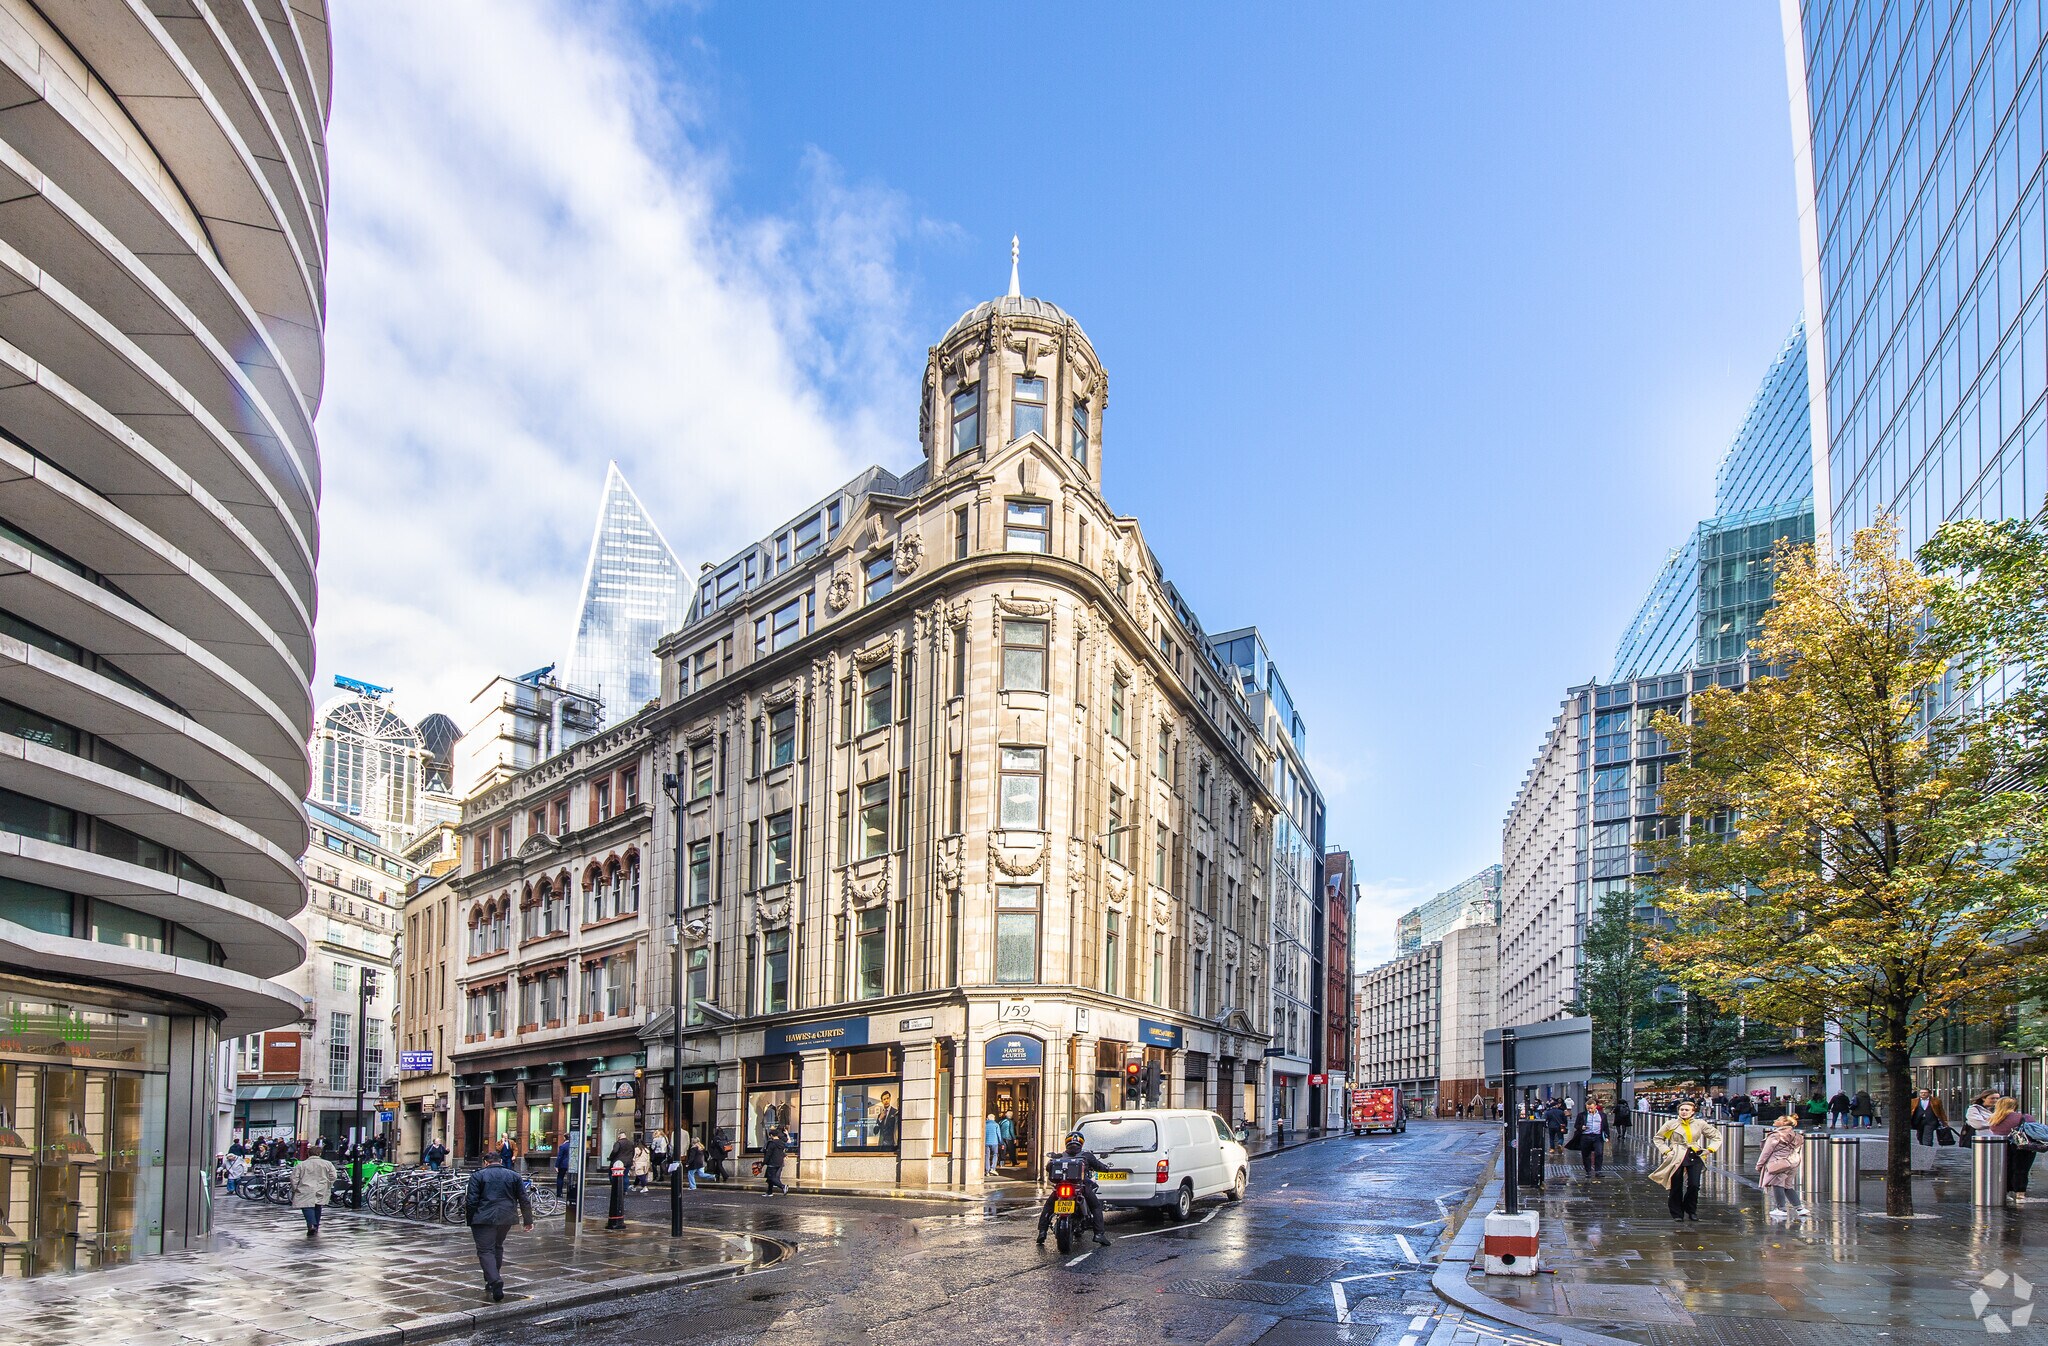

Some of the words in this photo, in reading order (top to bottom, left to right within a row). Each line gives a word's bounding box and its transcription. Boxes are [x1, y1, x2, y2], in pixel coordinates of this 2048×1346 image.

[1002, 1005, 1030, 1017] 159
[785, 1032, 811, 1042] HAWES
[816, 1028, 845, 1038] CURTIS
[684, 1071, 704, 1079] ALPHA
